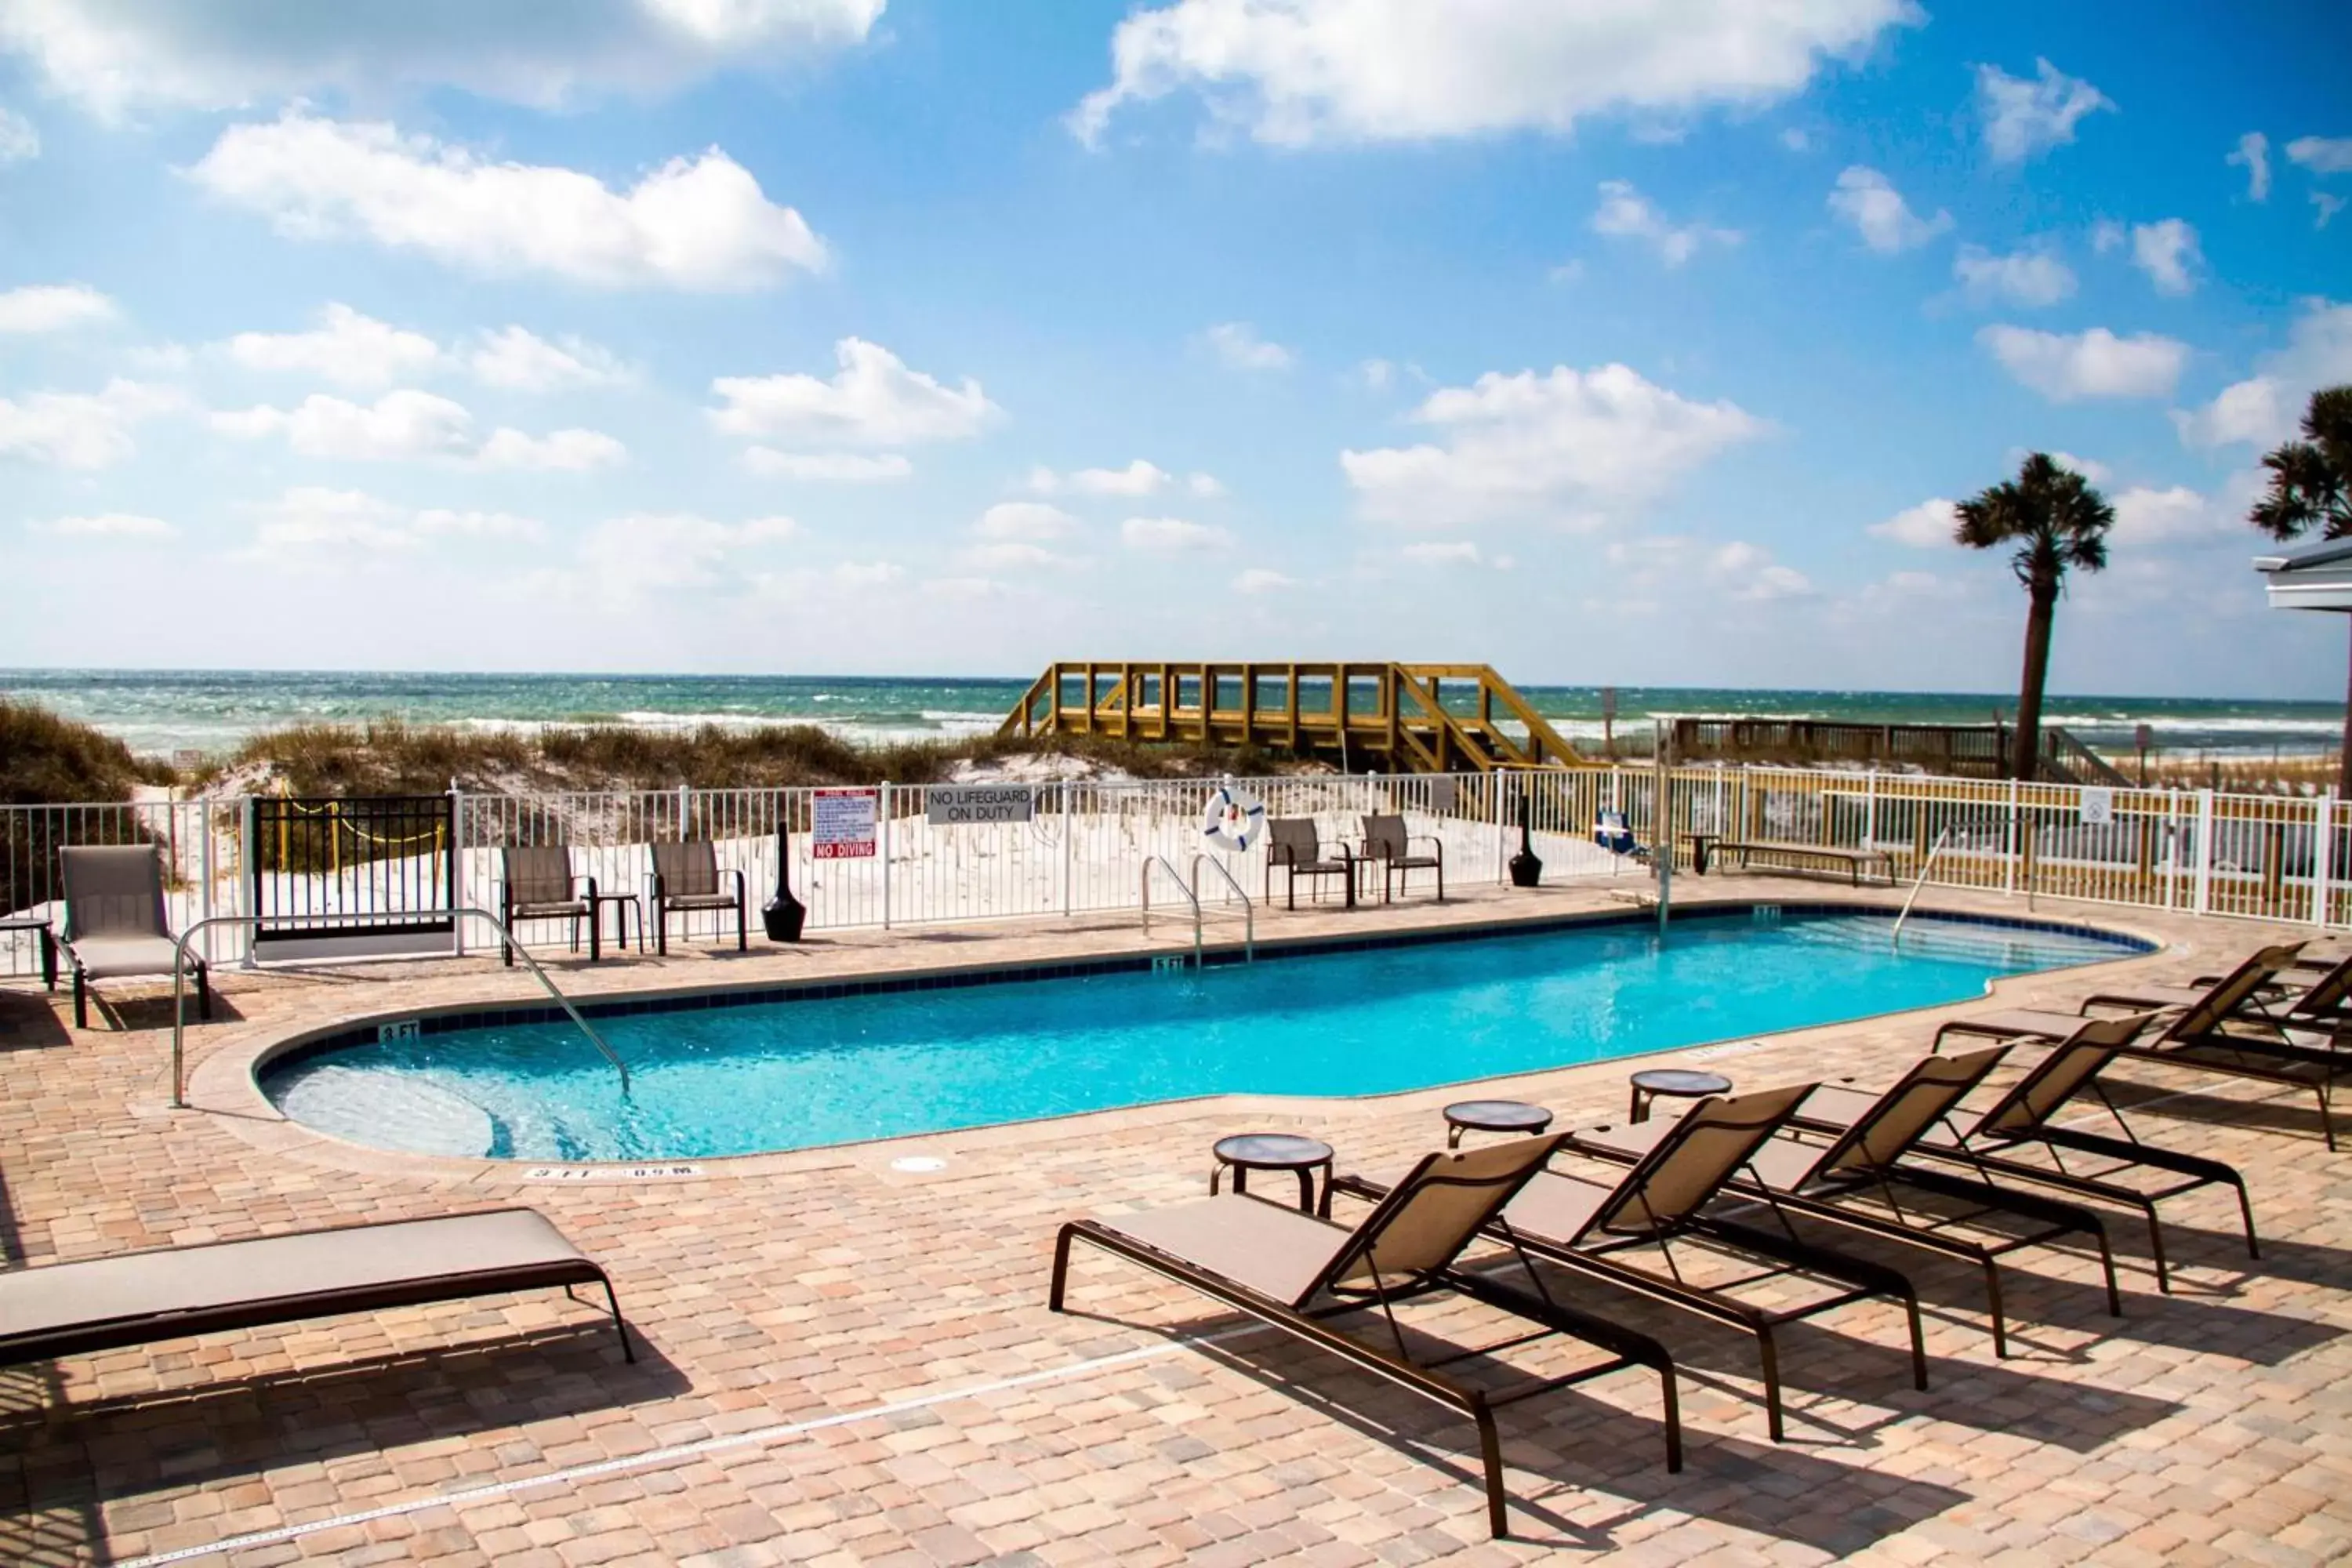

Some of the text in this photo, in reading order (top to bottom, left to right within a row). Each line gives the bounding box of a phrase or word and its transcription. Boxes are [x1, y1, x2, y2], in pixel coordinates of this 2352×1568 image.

[930, 789, 1030, 805] NO LIFEGUARD
[948, 805, 1014, 821] ON DUTY
[816, 843, 873, 857] NO DIVING
[399, 1023, 417, 1039] FT
